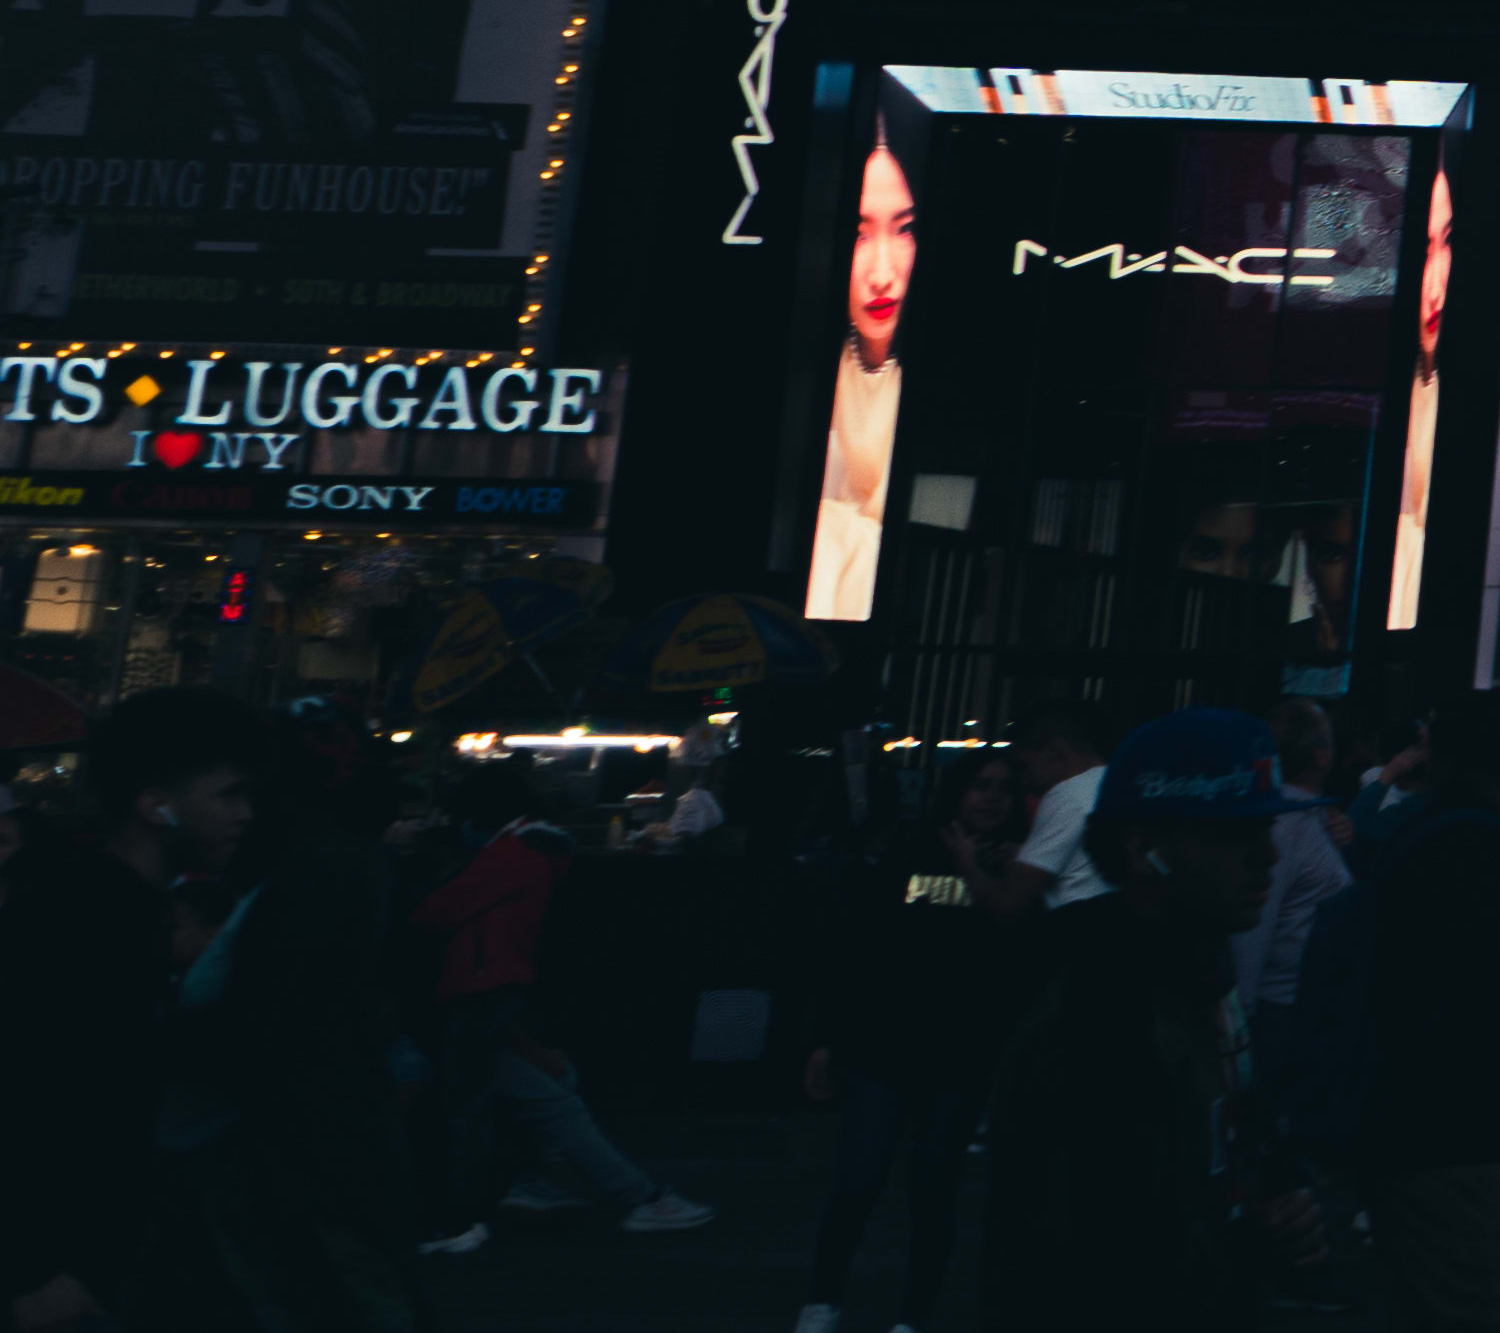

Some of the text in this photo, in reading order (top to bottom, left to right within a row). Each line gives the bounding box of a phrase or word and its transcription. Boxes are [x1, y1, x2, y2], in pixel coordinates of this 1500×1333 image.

[0, 156, 204, 209] ROPPING
[74, 273, 240, 302] ETHERWORLD
[0, 356, 602, 434] TS LUGGAGE
[125, 430, 298, 470] I NY
[286, 484, 436, 512] SONY
[454, 485, 567, 515] BOWER
